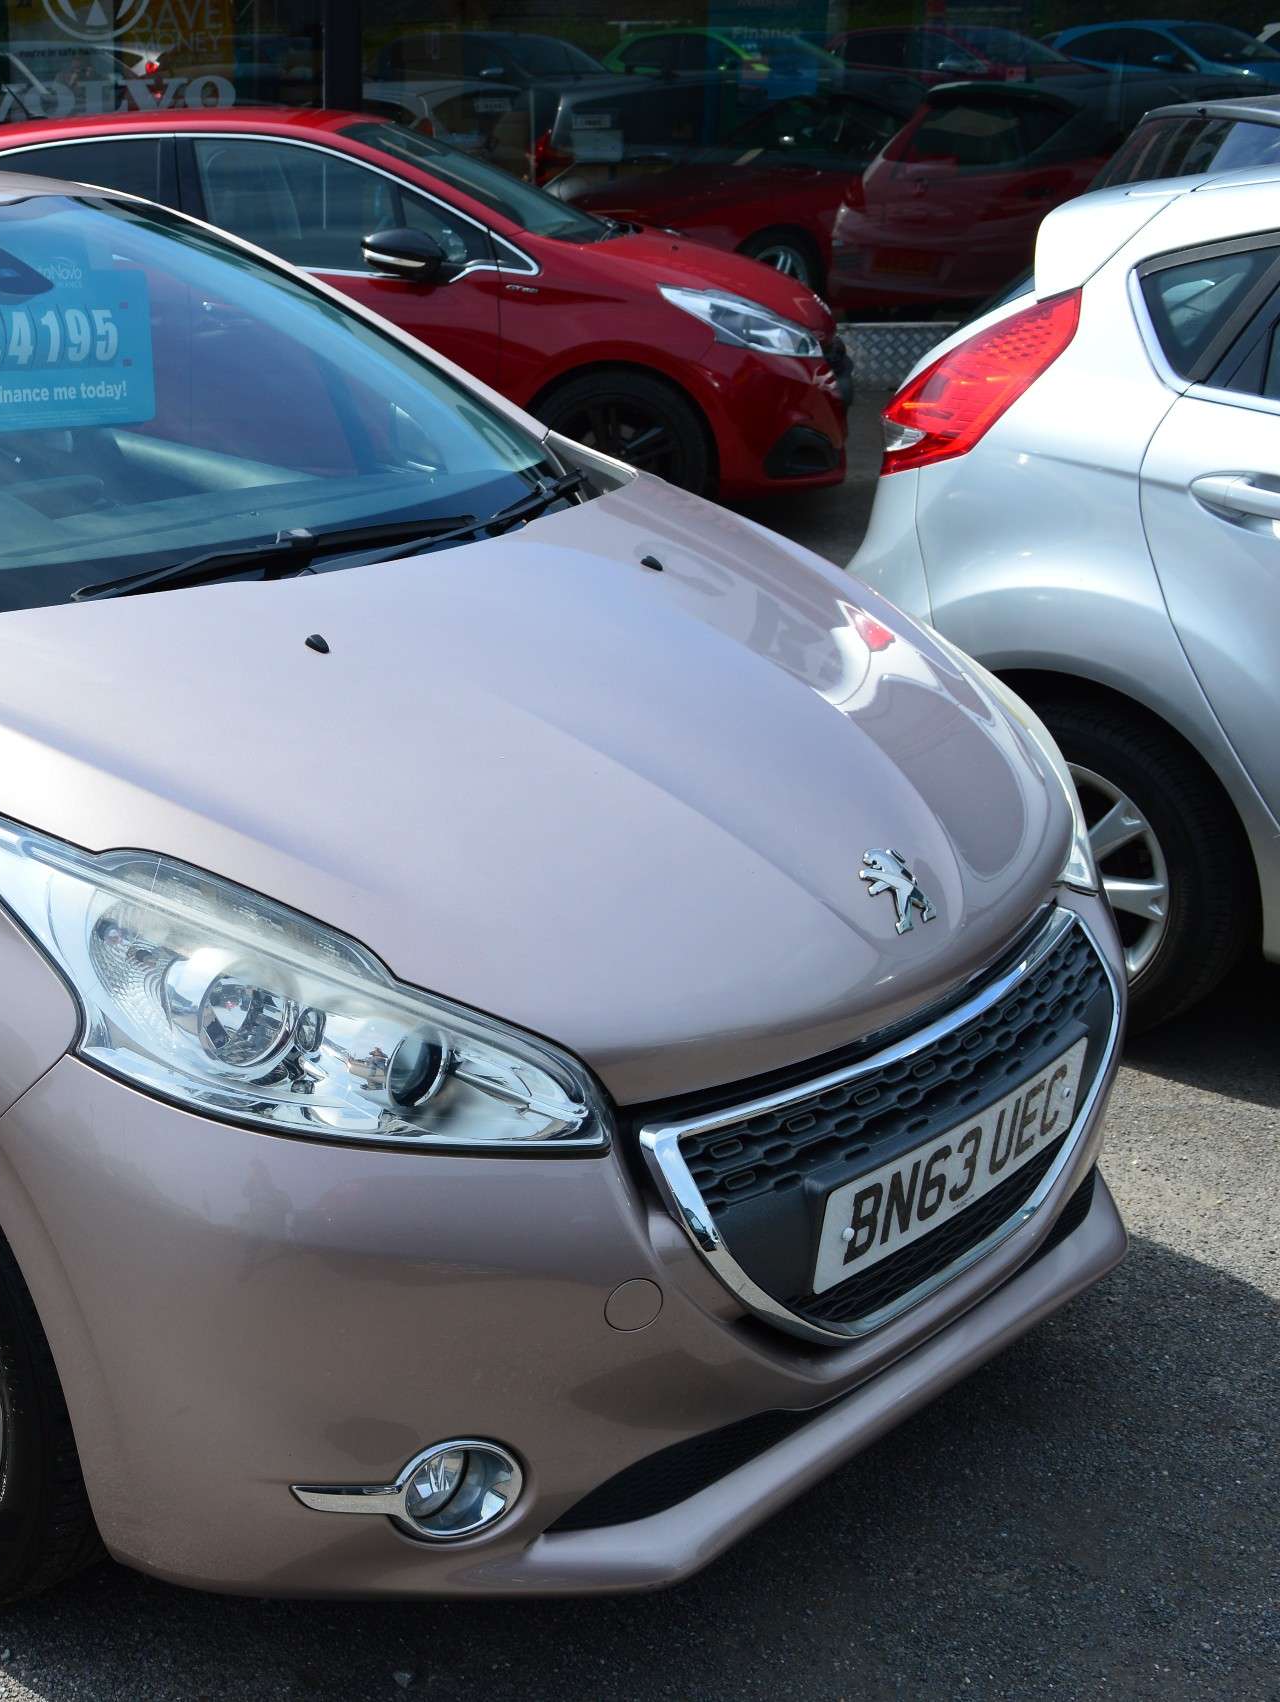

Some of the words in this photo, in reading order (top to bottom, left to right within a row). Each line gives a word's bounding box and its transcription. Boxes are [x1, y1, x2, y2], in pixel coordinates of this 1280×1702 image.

[53, 386, 77, 401] me
[80, 380, 128, 400] today!
[842, 1125, 983, 1266] BN63
[988, 1063, 1068, 1176] UEC
